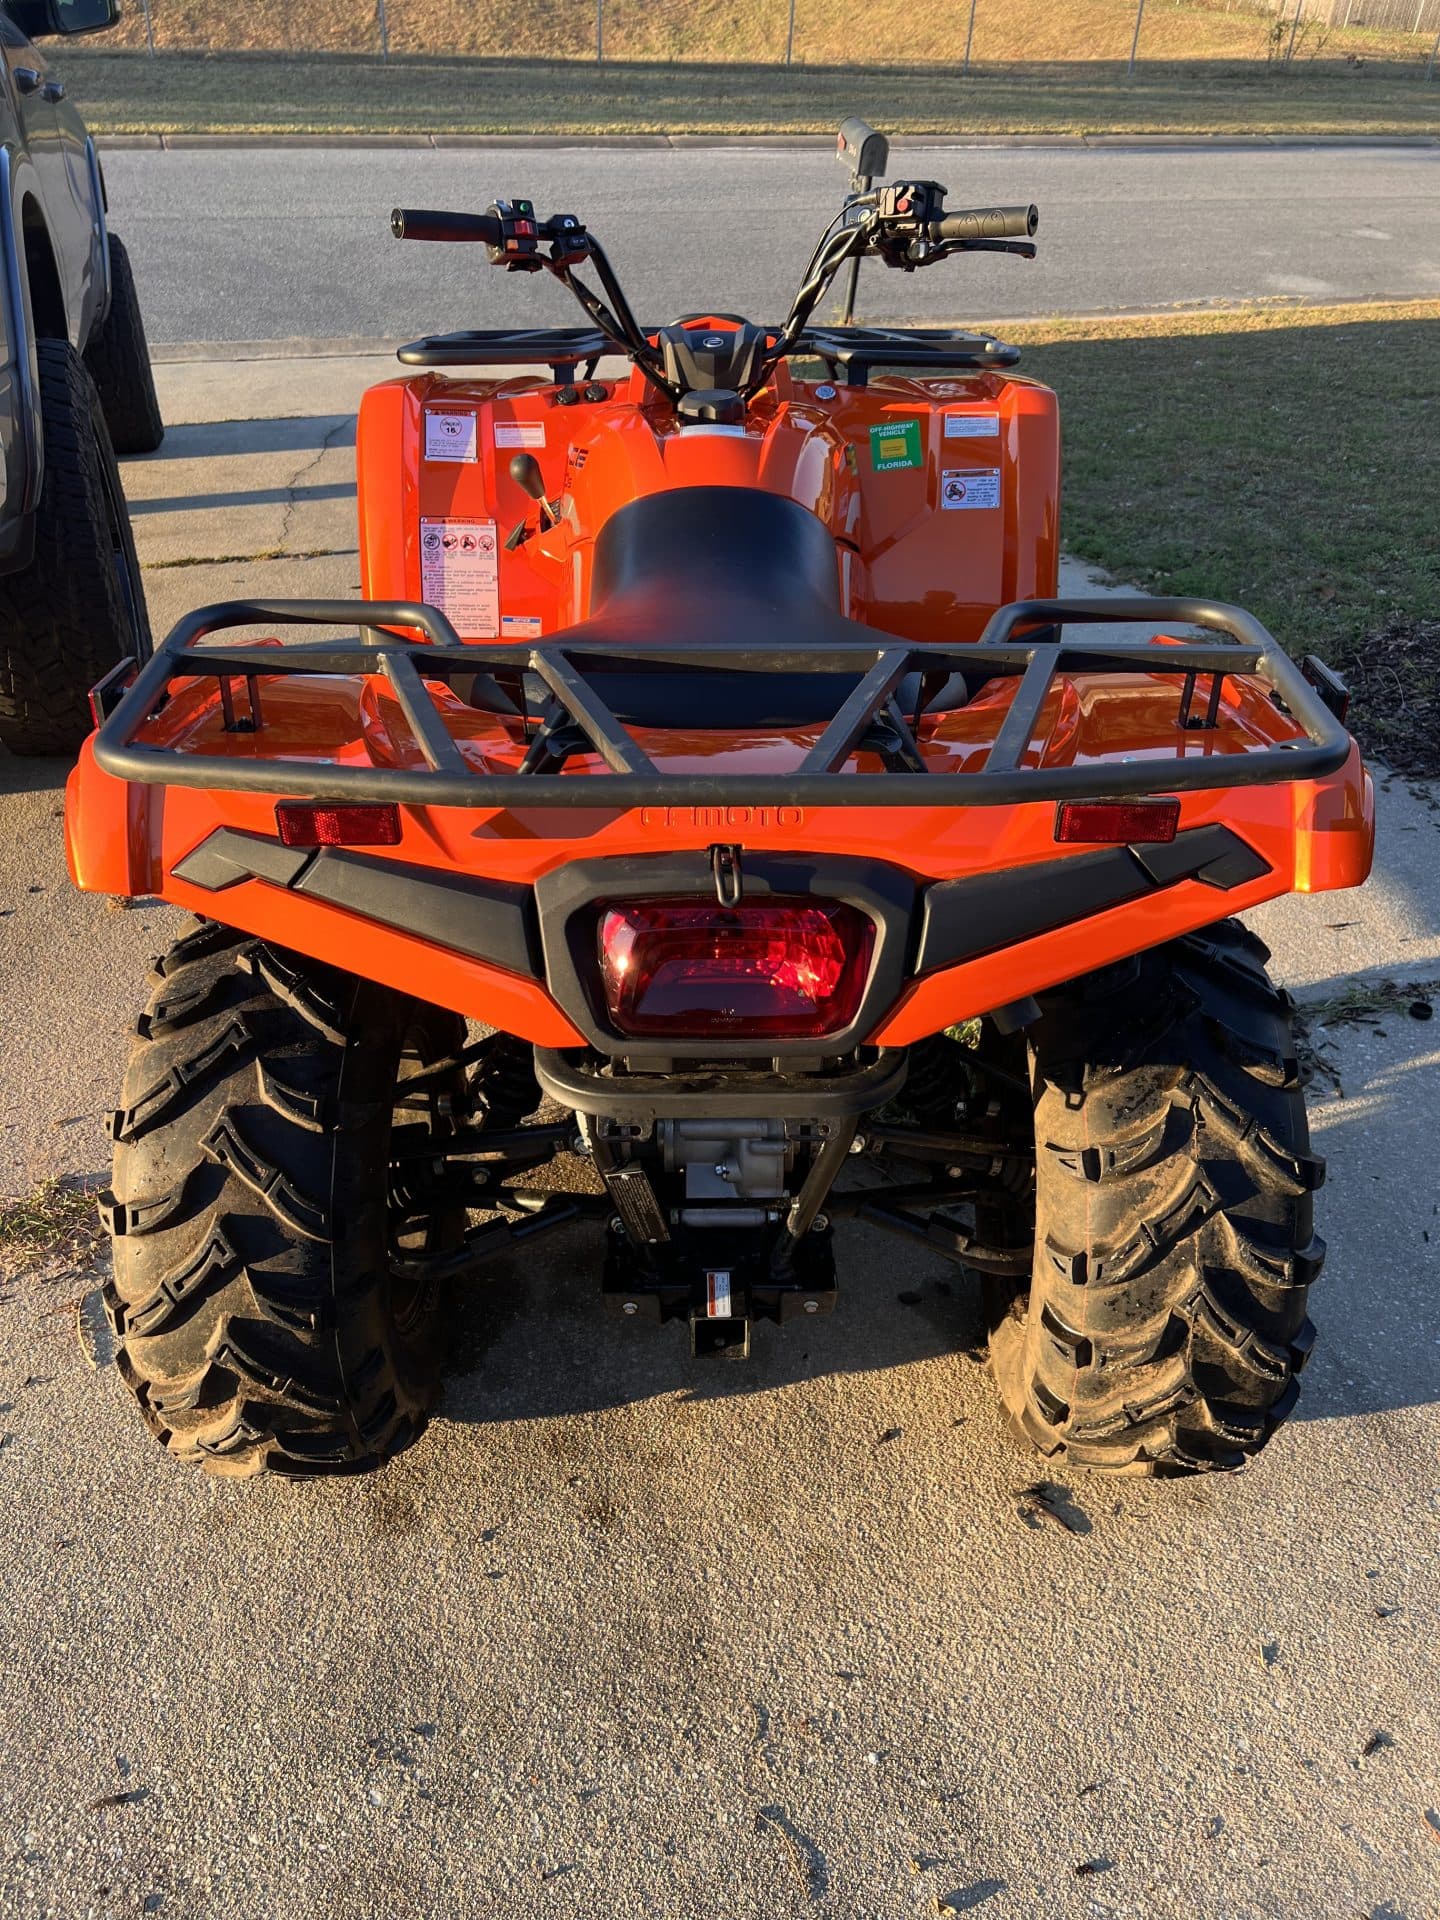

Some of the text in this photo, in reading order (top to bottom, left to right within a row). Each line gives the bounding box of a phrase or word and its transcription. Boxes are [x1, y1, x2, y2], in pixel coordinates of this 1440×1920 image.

[870, 423, 914, 433] OFF-HIGHWAY
[879, 429, 906, 437] VEHICLE
[877, 460, 913, 470] FLORIDA
